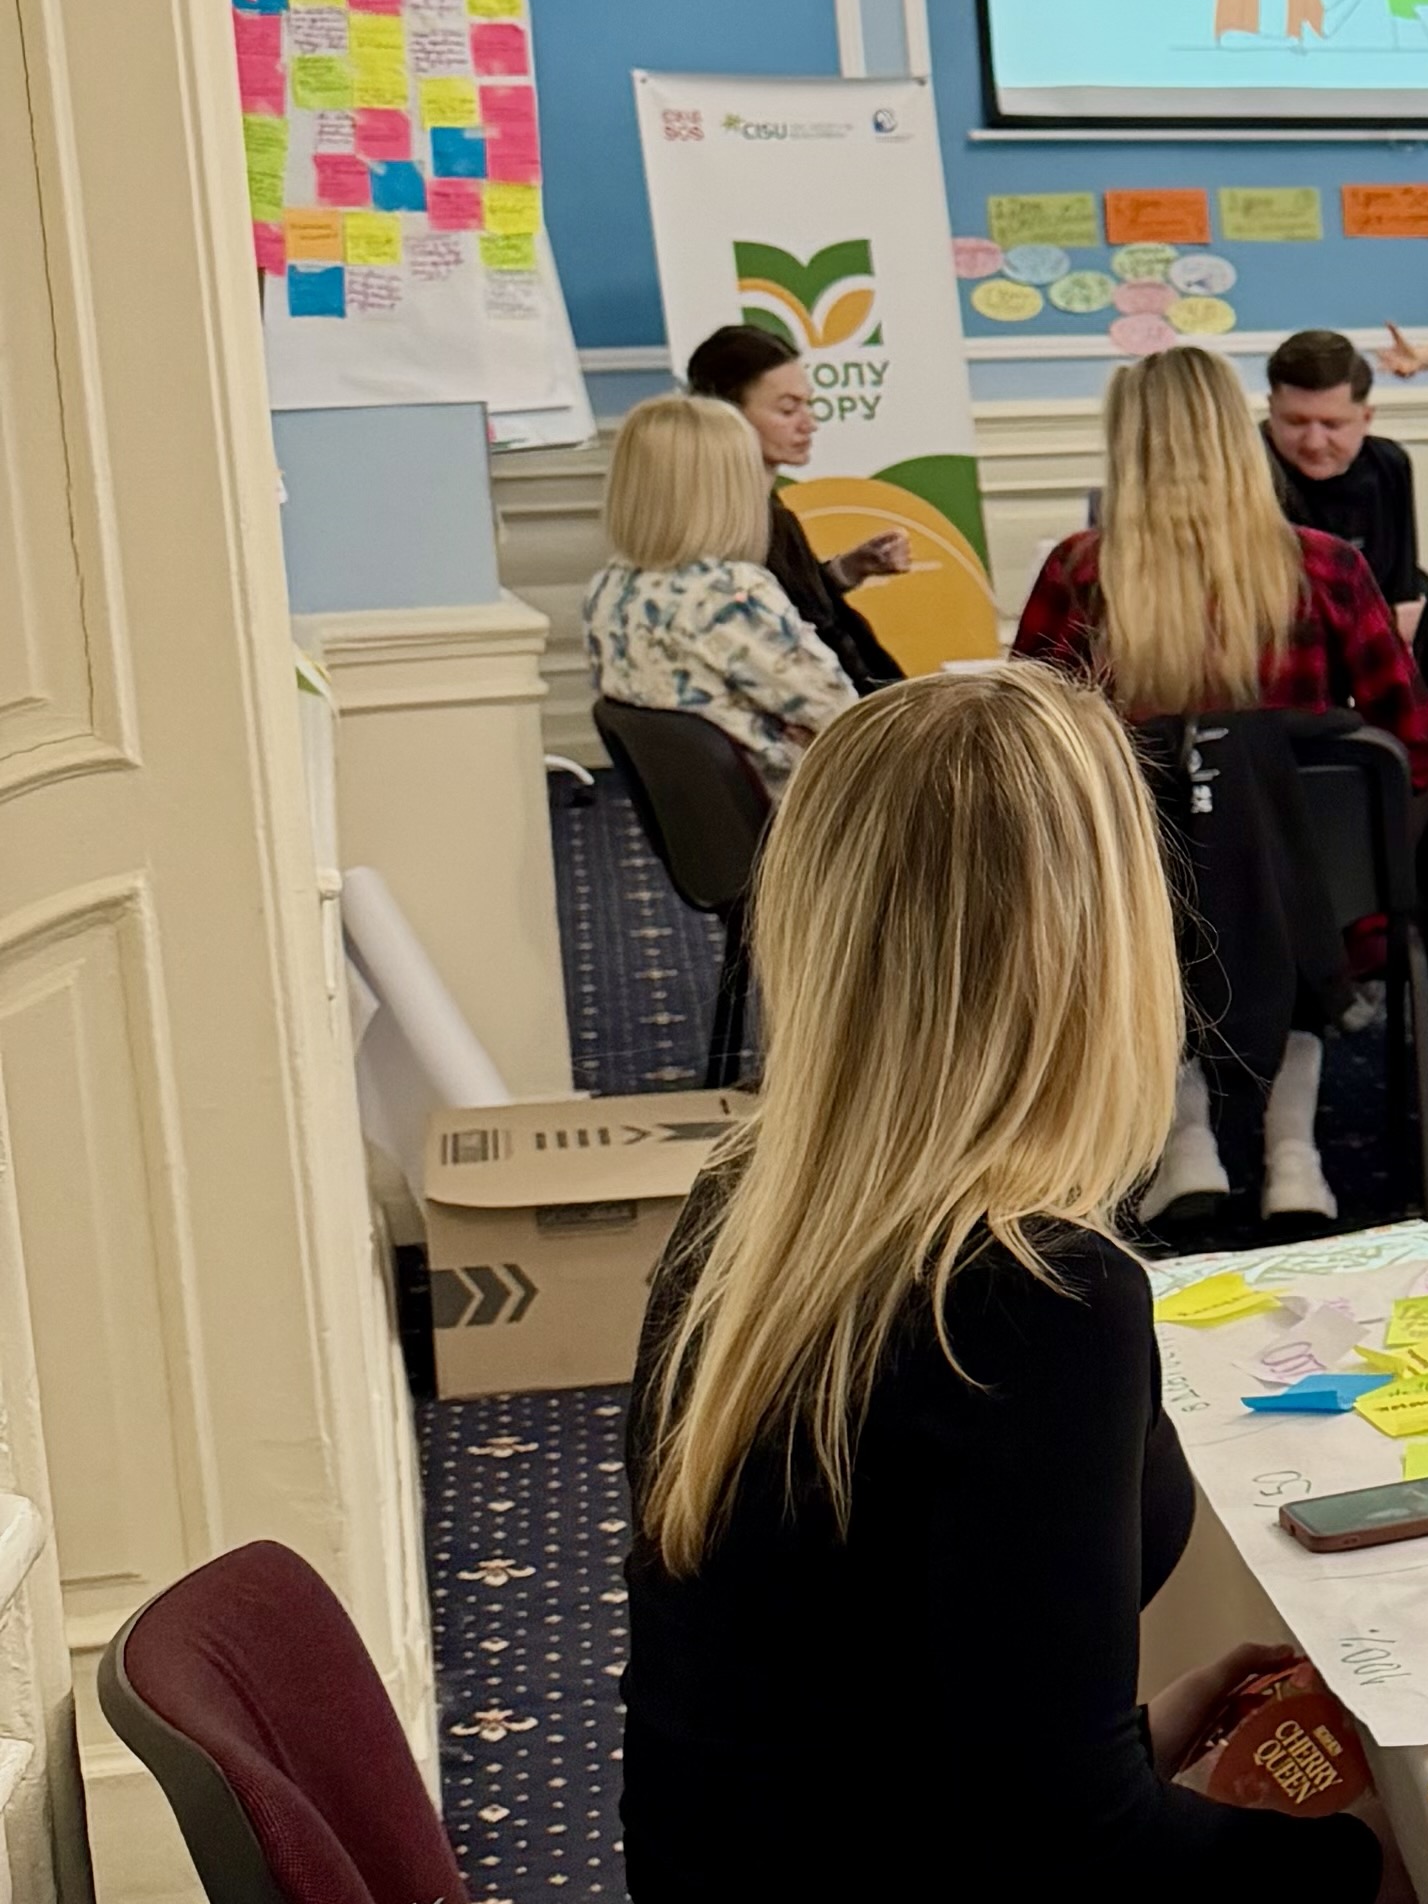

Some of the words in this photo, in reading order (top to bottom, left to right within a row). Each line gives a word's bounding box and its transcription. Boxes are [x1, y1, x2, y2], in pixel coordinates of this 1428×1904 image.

[742, 122, 788, 140] CISU
[804, 361, 889, 389] ОЛУ
[1339, 1628, 1412, 1686] 100%
[1253, 1739, 1318, 1804] QUEEN
[1275, 1720, 1343, 1791] CHERRY
